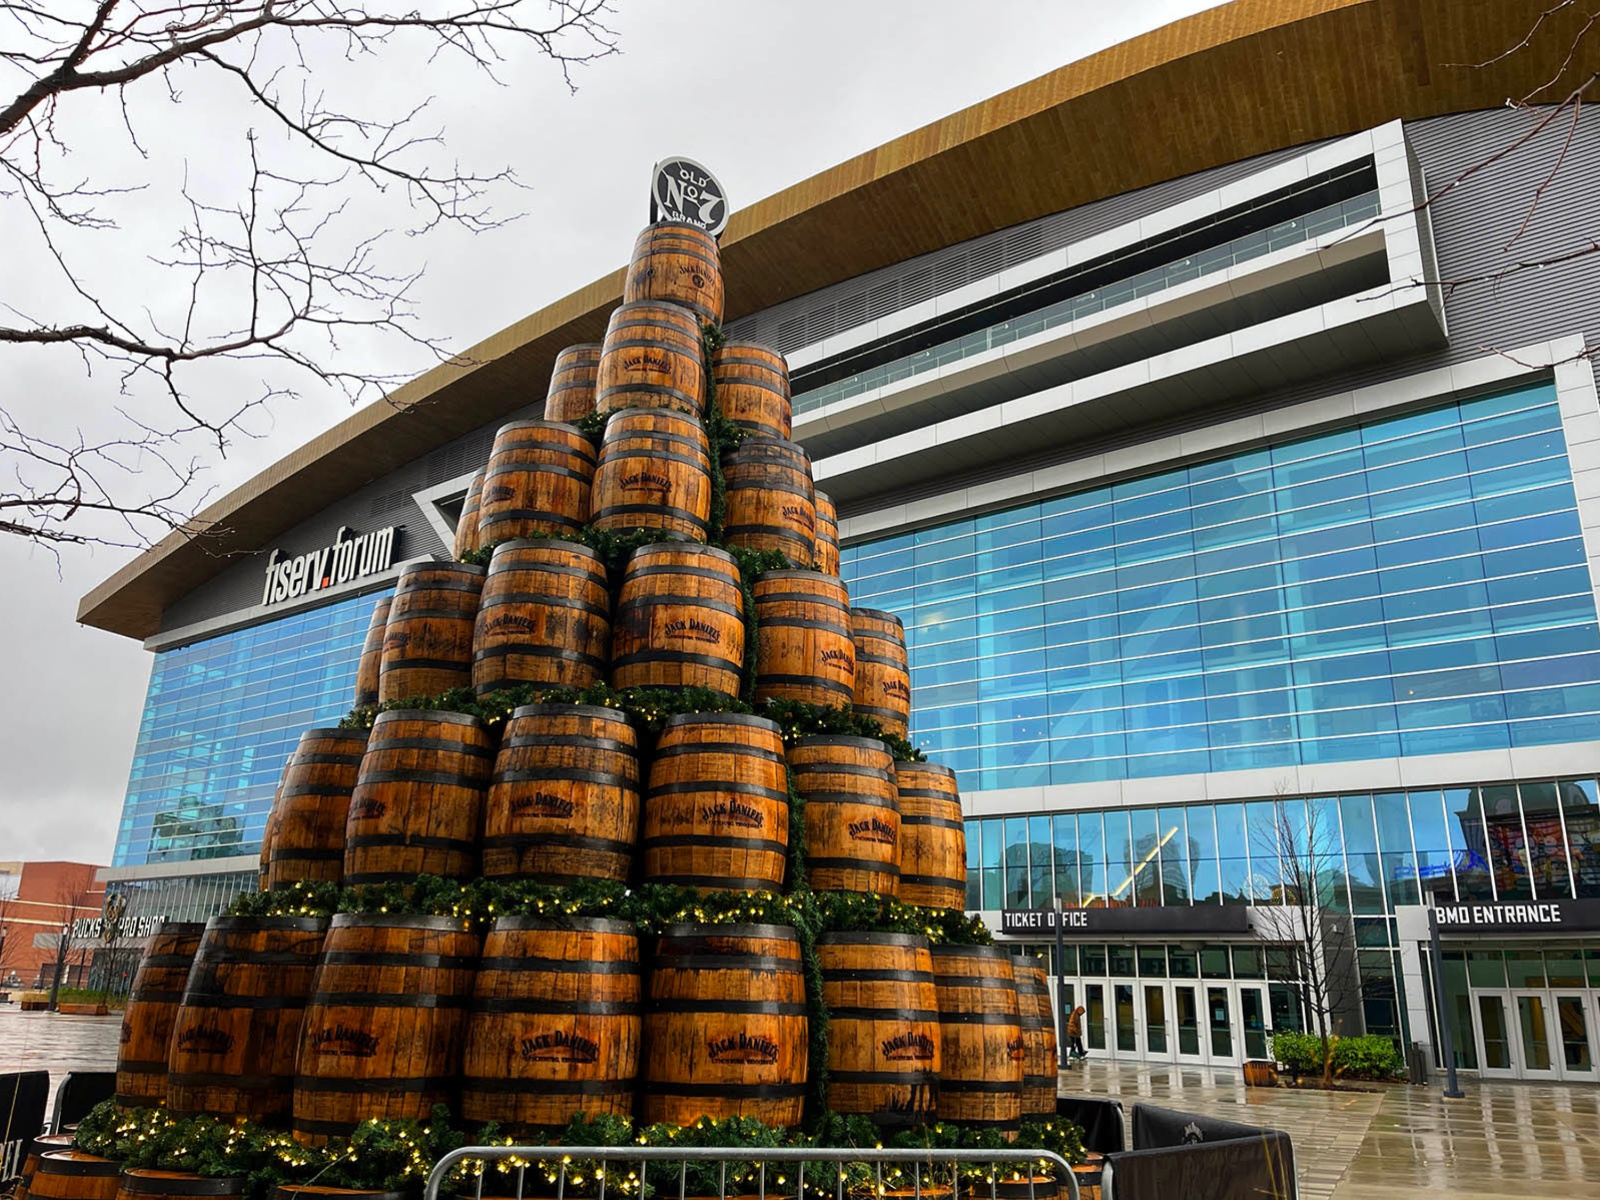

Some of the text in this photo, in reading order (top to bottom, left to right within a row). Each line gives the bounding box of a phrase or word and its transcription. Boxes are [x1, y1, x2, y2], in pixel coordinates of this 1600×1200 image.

[680, 169, 707, 187] OLD
[623, 357, 641, 370] JACK
[619, 475, 638, 490] JACK
[782, 506, 798, 517] JACK
[664, 620, 685, 636] JACK
[689, 618, 720, 641] DANIEL'S
[820, 650, 837, 662] JACK
[883, 681, 896, 693] JACK
[535, 791, 573, 816] DANIEL'S
[702, 799, 763, 820] JACK DANIEL'S
[848, 821, 870, 838] JACK
[1005, 912, 1087, 927] TICKET OFICE
[1436, 904, 1561, 924] BMO ENTRANCE
[521, 1030, 598, 1059] JACK DANIEL'S
[708, 1033, 778, 1059] JACK DANIEL'S
[881, 1035, 905, 1057] JACK
